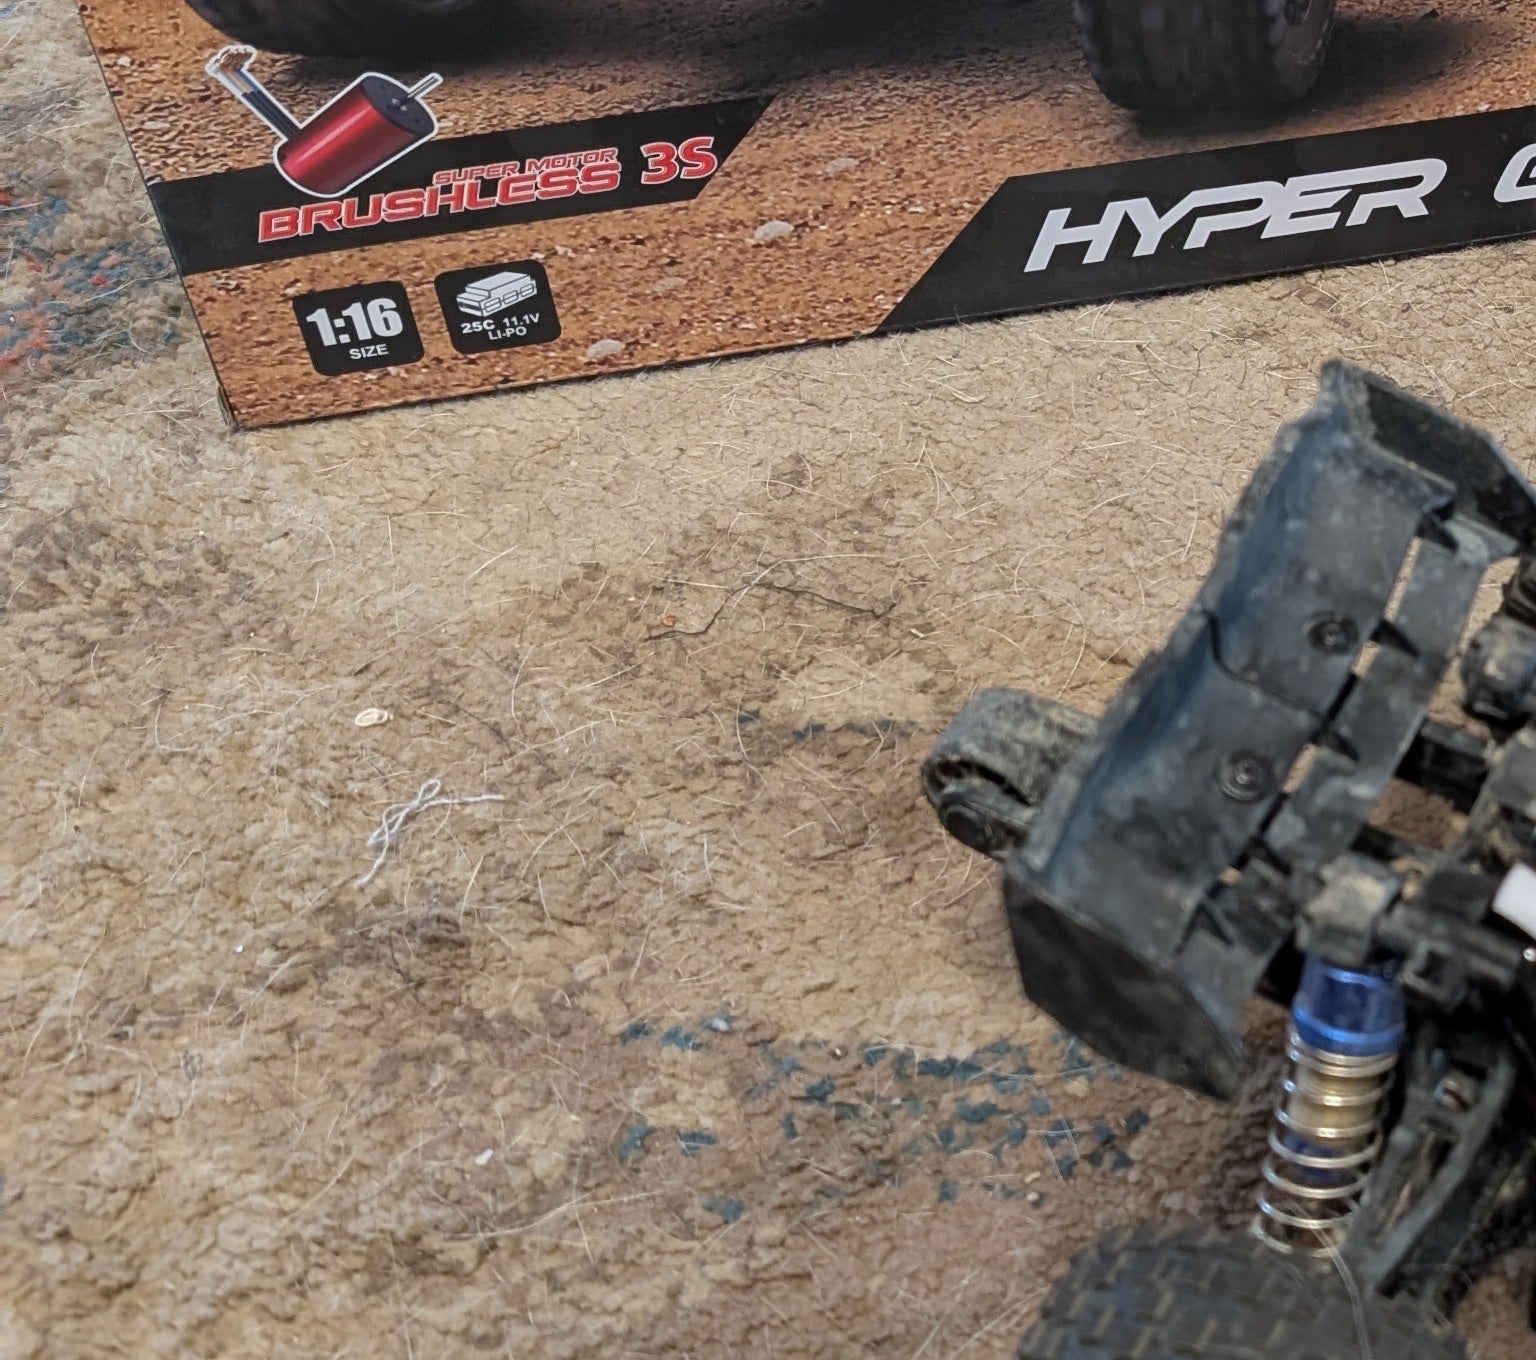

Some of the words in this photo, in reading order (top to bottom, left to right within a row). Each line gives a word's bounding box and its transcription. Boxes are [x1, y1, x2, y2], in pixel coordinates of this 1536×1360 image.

[434, 161, 518, 186] SUPER
[528, 147, 618, 176] MOTOR
[258, 162, 621, 243] BRUSHLESS
[640, 136, 718, 185] 3S
[1023, 158, 1448, 273] HYPER
[306, 296, 404, 347] 1:16
[461, 319, 495, 334] 25C
[503, 312, 540, 328] 11.1V
[488, 326, 527, 340] LI-PO
[349, 343, 388, 360] SIZE
